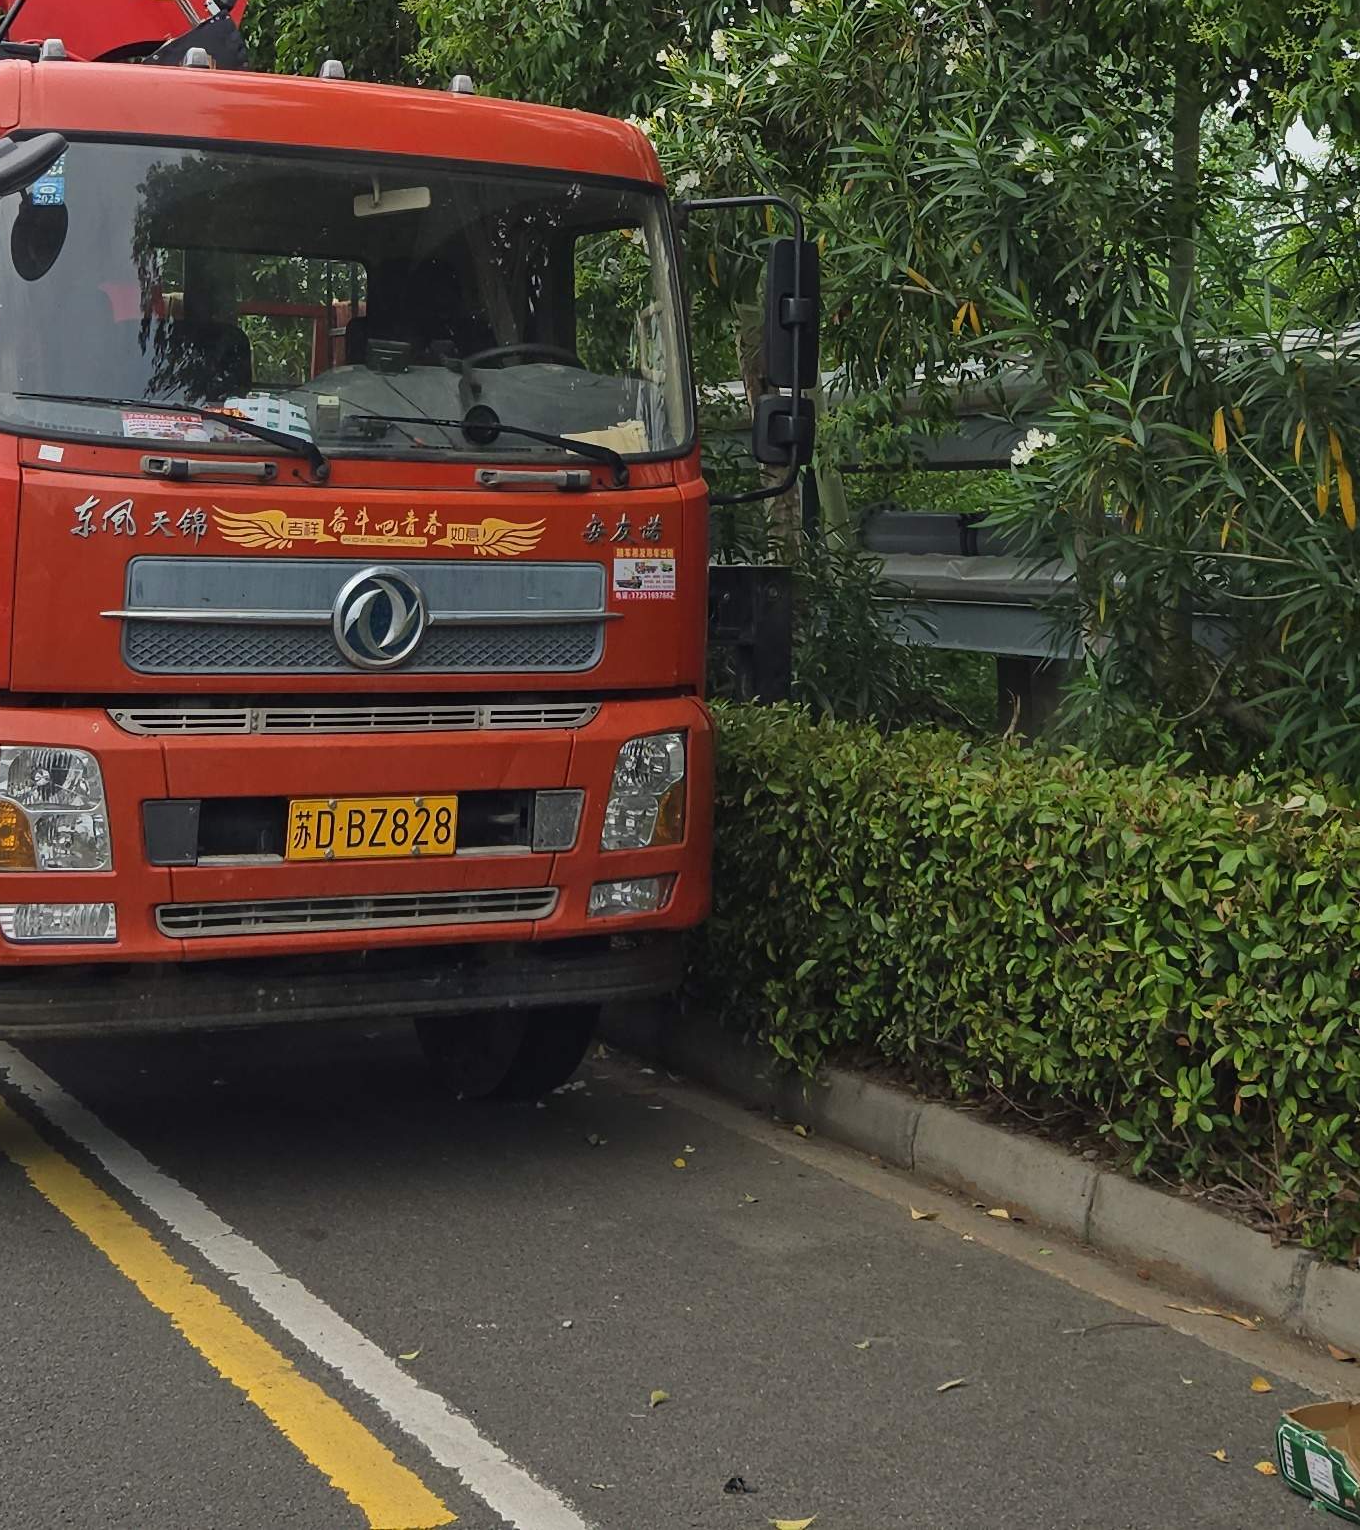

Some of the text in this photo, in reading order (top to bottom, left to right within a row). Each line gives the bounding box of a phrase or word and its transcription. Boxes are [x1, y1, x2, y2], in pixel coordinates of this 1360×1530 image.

[71, 494, 208, 548] 东风 天锦
[287, 521, 320, 536] 吉祥
[328, 506, 442, 537] 奋斗吧青春
[294, 807, 451, 849] 苏D·BZ828
